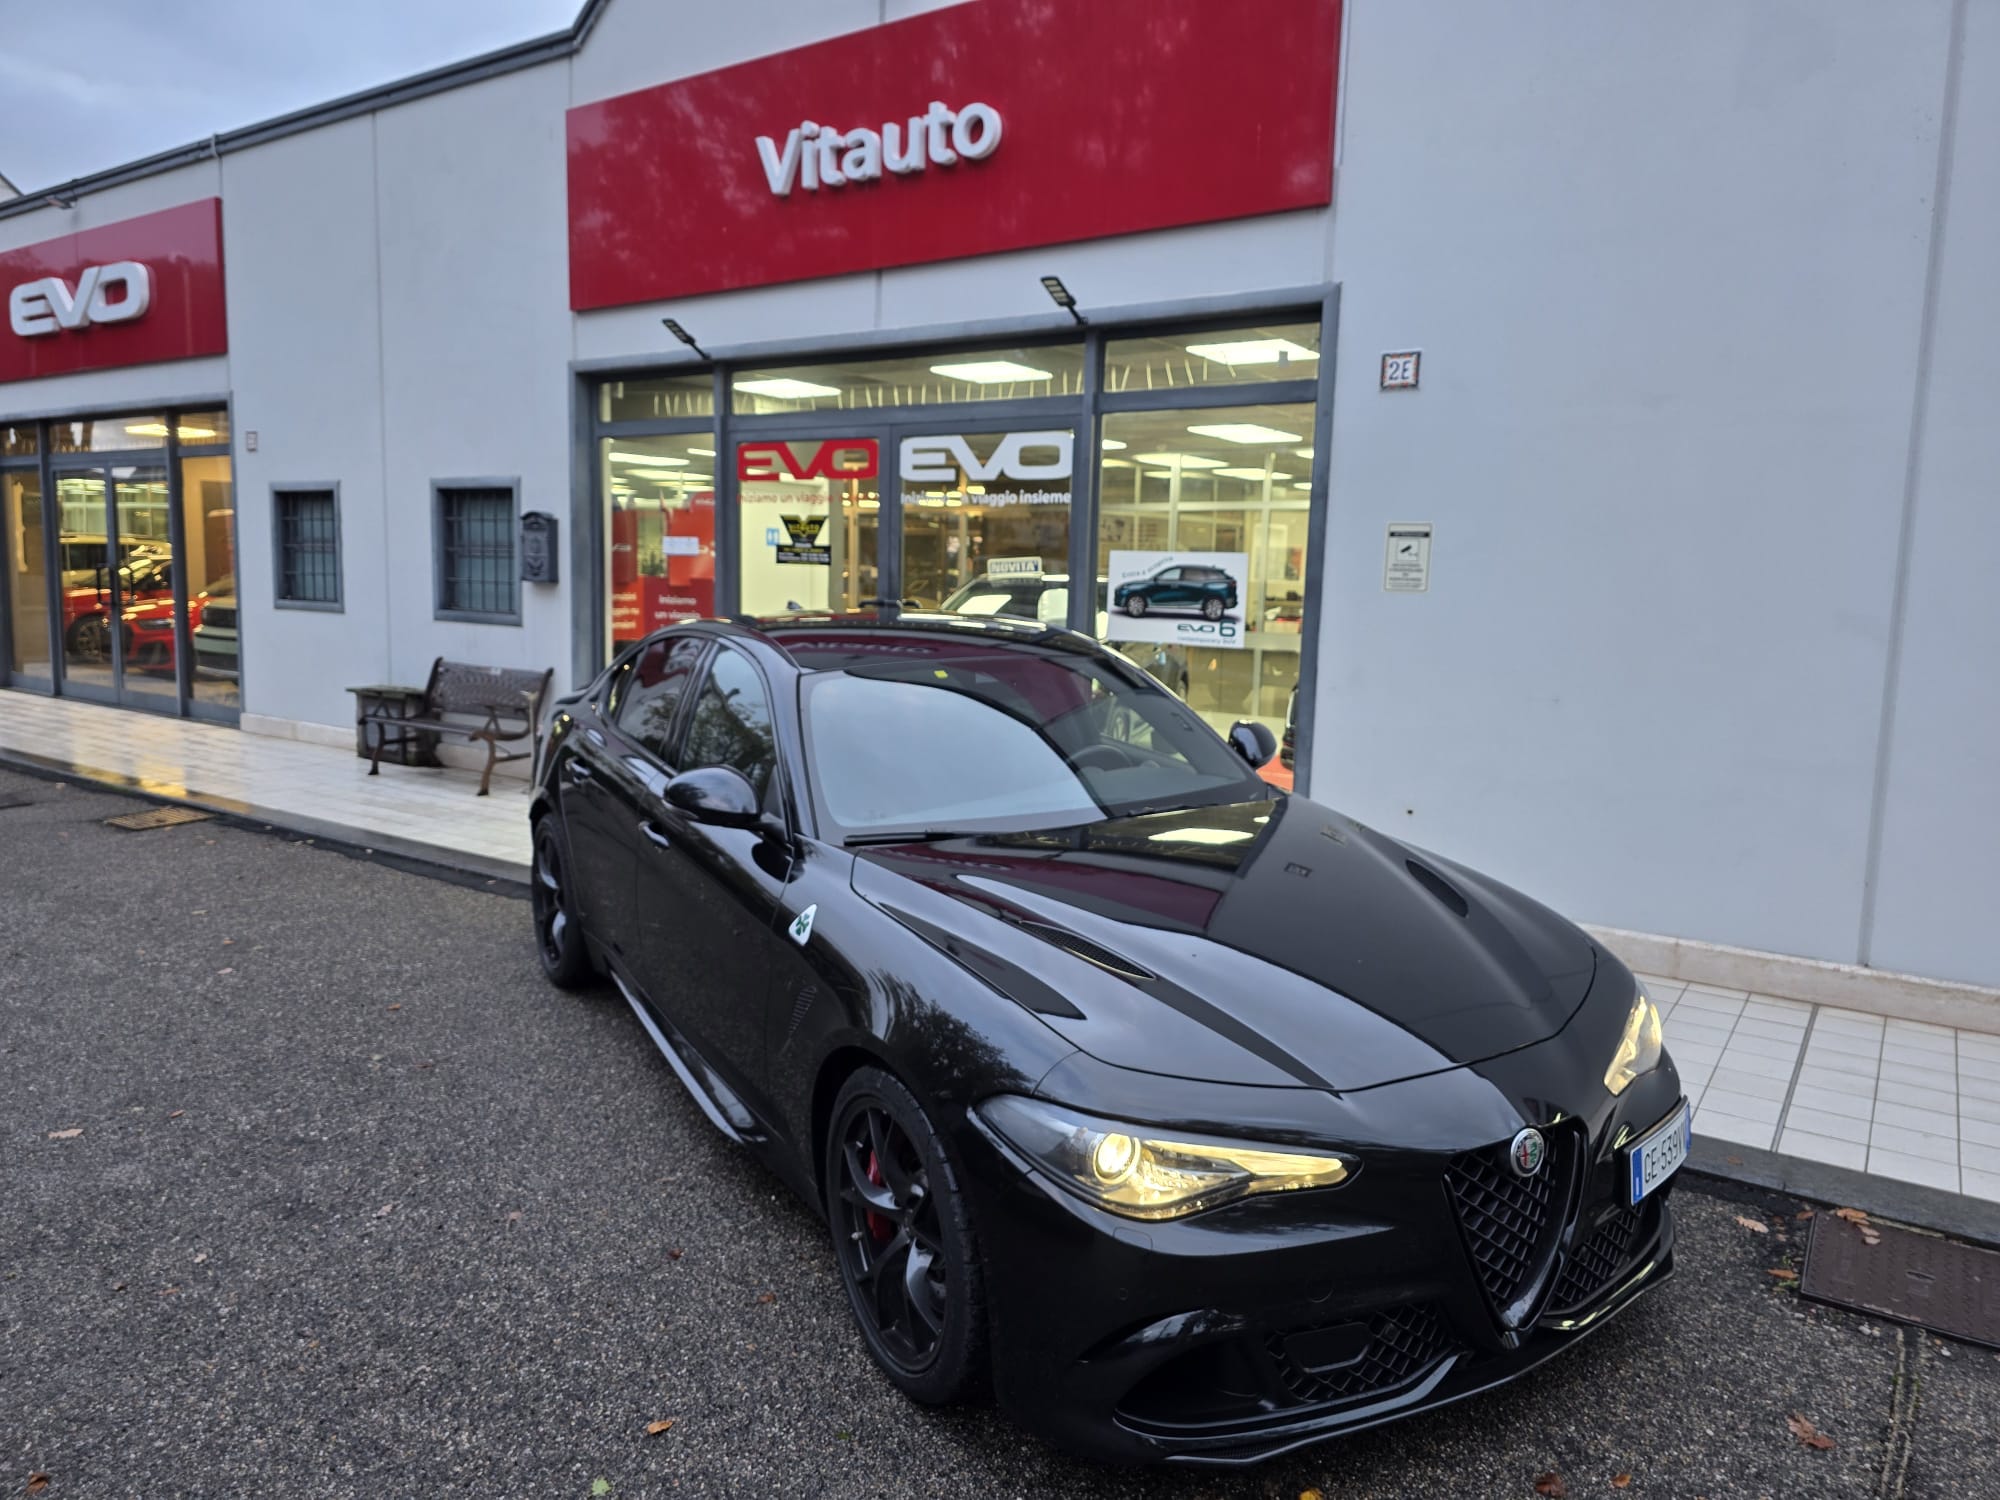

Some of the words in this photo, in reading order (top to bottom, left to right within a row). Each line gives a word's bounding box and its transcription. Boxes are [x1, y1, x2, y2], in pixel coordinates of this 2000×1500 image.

[755, 101, 1003, 196] Vitauto
[9, 260, 151, 337] EVO
[1389, 360, 1412, 380] 2E
[737, 439, 880, 481] EVO
[899, 431, 1075, 482] EVO
[971, 490, 1018, 508] viaggio
[1019, 489, 1073, 504] insieme
[1177, 623, 1215, 633] EVO
[1219, 619, 1237, 637] 6
